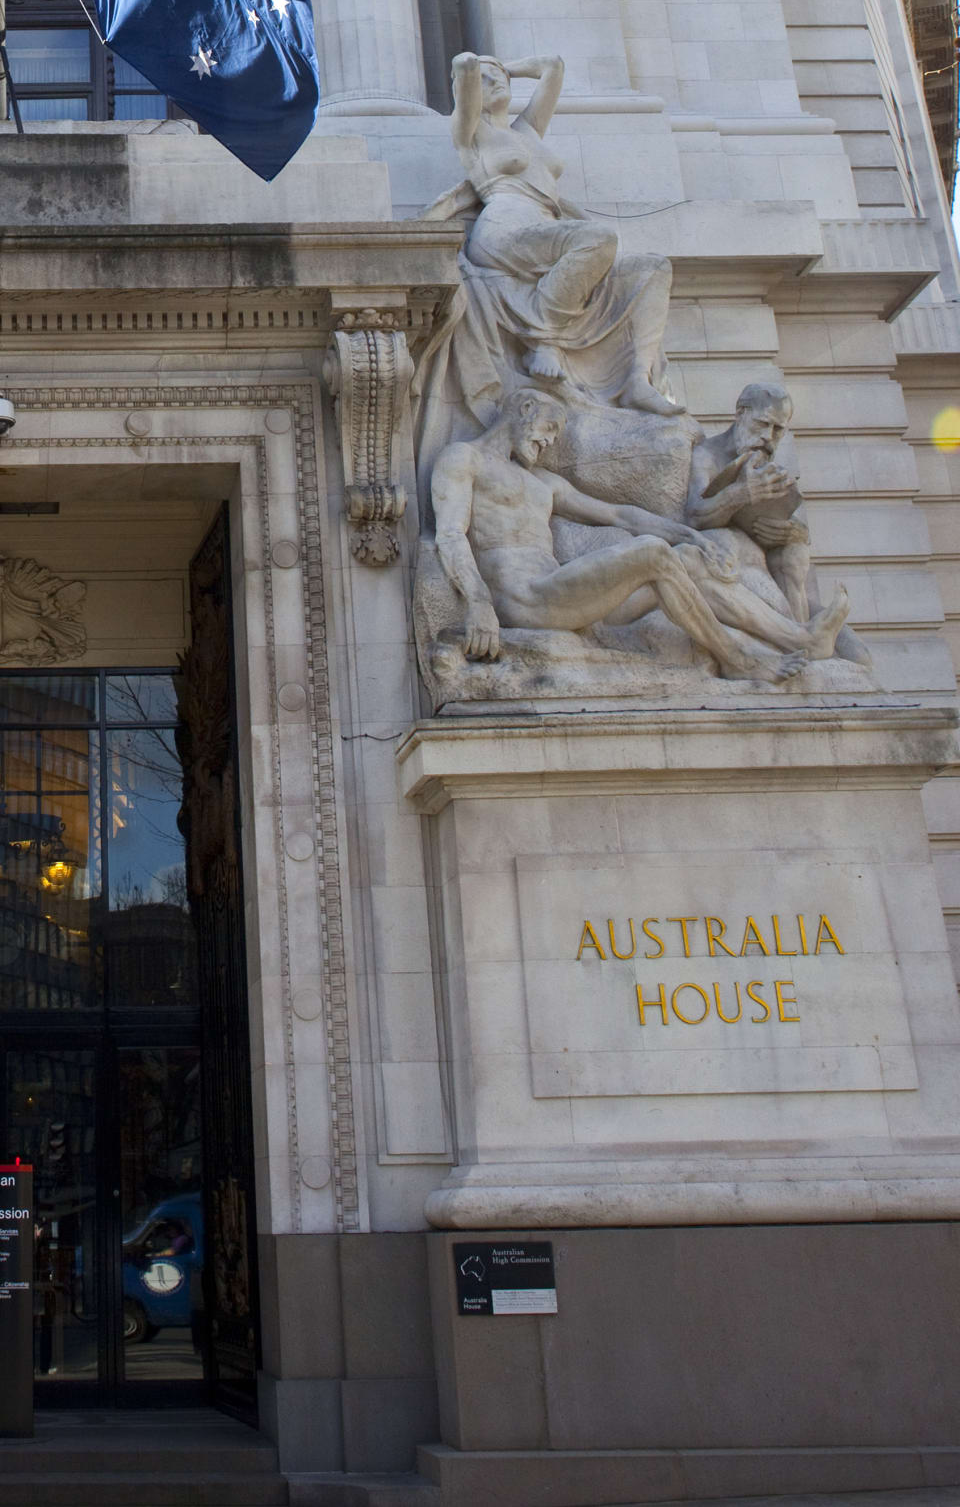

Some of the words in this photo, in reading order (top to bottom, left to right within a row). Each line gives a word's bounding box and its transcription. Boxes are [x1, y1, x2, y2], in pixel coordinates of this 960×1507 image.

[576, 914, 848, 961] AUSTRALIA
[635, 980, 801, 1026] HOUSE
[492, 1256, 509, 1265] High
